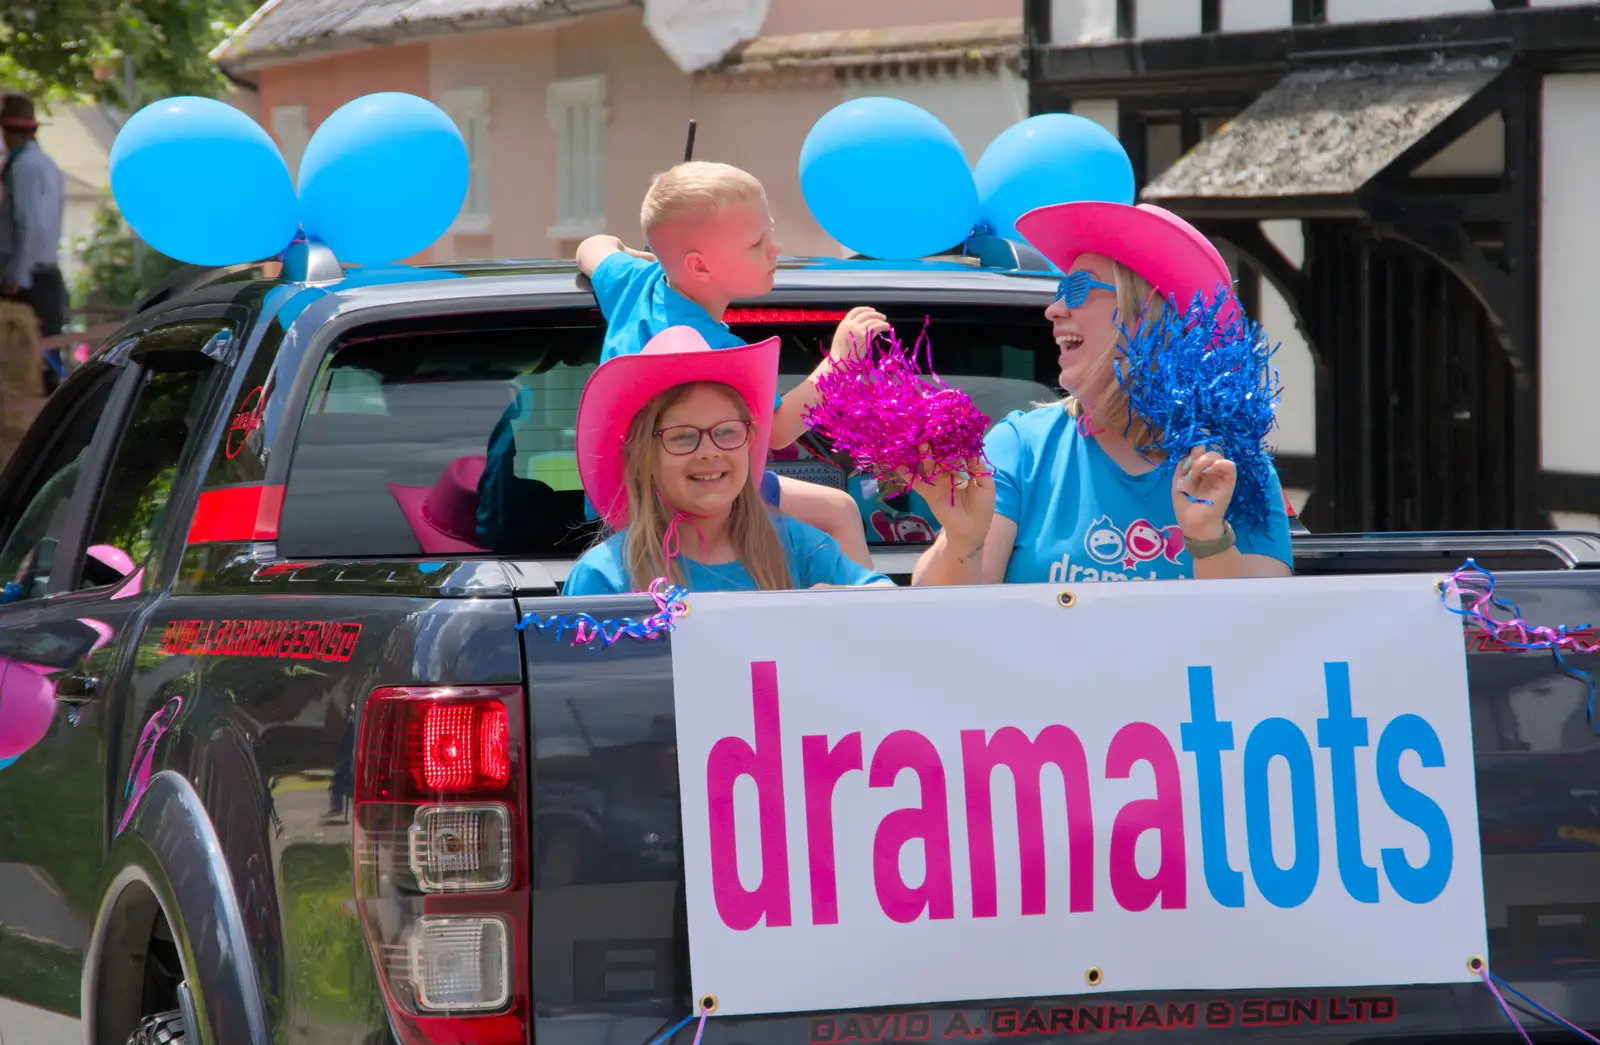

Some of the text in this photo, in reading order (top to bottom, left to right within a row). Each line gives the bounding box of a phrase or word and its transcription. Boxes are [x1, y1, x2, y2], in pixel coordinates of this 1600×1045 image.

[706, 661, 1454, 931] dramatots
[809, 996, 1397, 1045] DAVID A. GARNHAM & SON LTD
